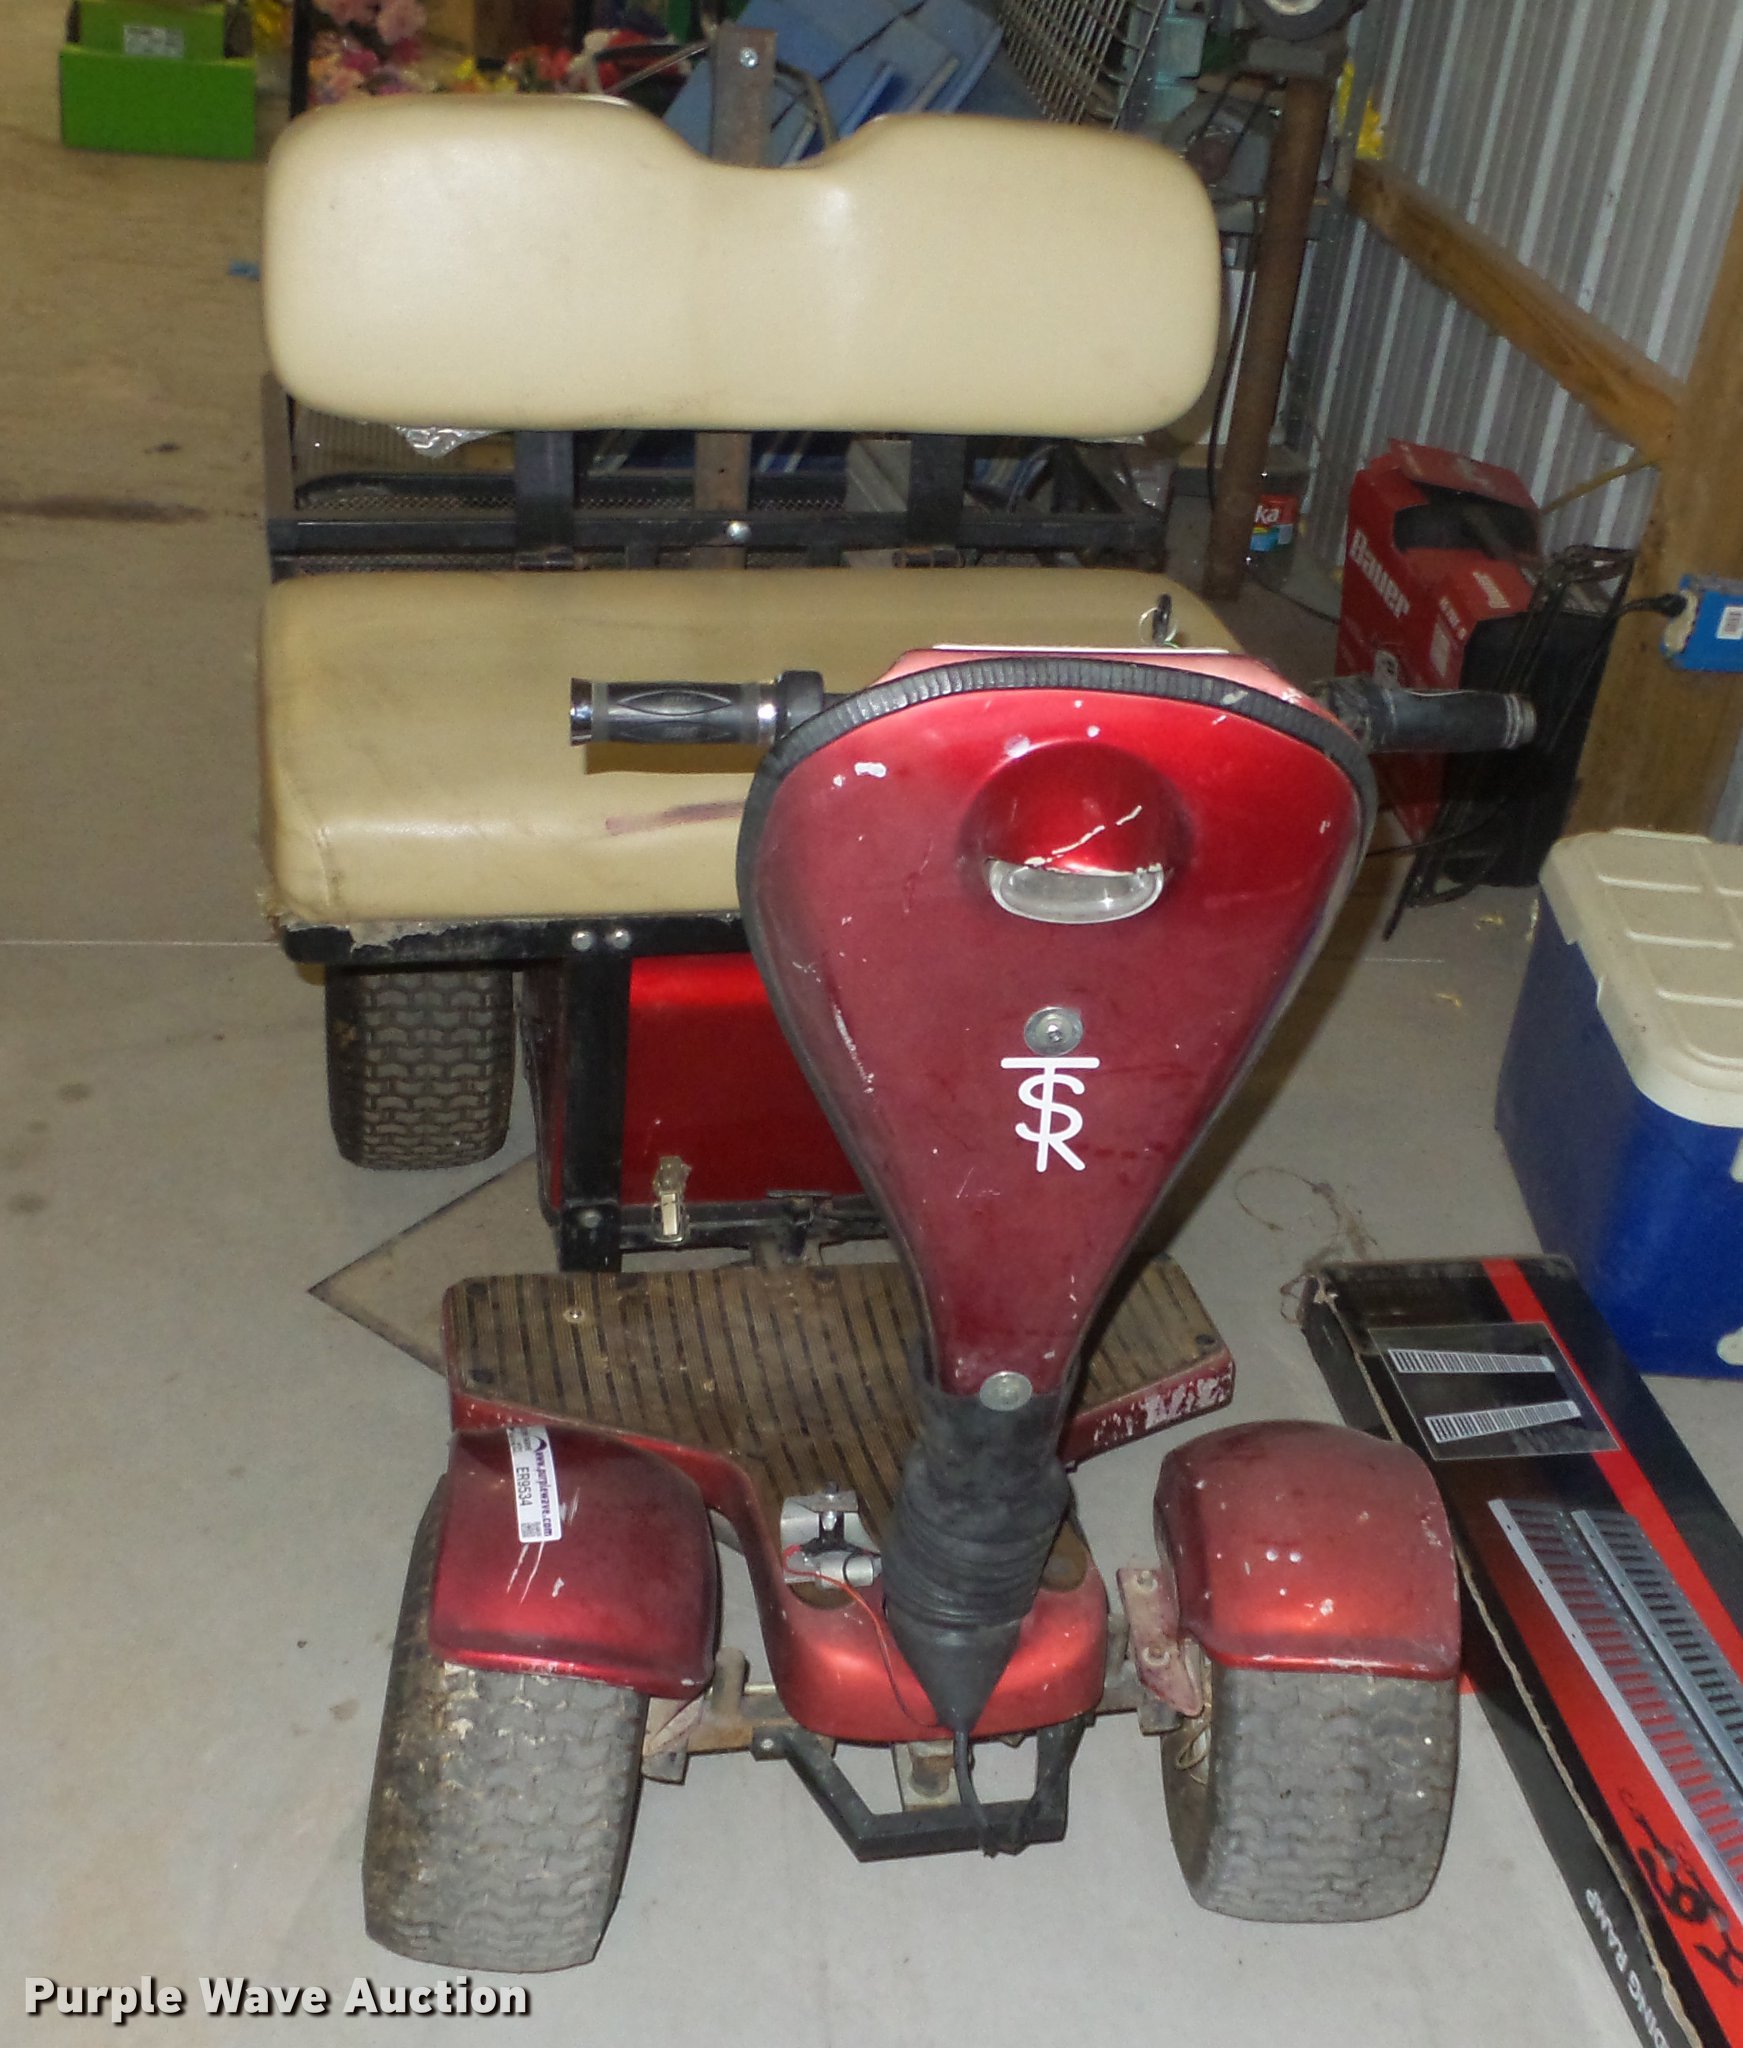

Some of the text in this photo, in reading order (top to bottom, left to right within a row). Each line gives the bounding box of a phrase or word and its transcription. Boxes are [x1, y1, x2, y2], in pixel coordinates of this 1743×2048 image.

[1350, 528, 1411, 618] Bauer
[516, 1466, 533, 1507] ER9534
[534, 1451, 553, 1537] www.purplewave.com
[1585, 1888, 1628, 1973] RAMP
